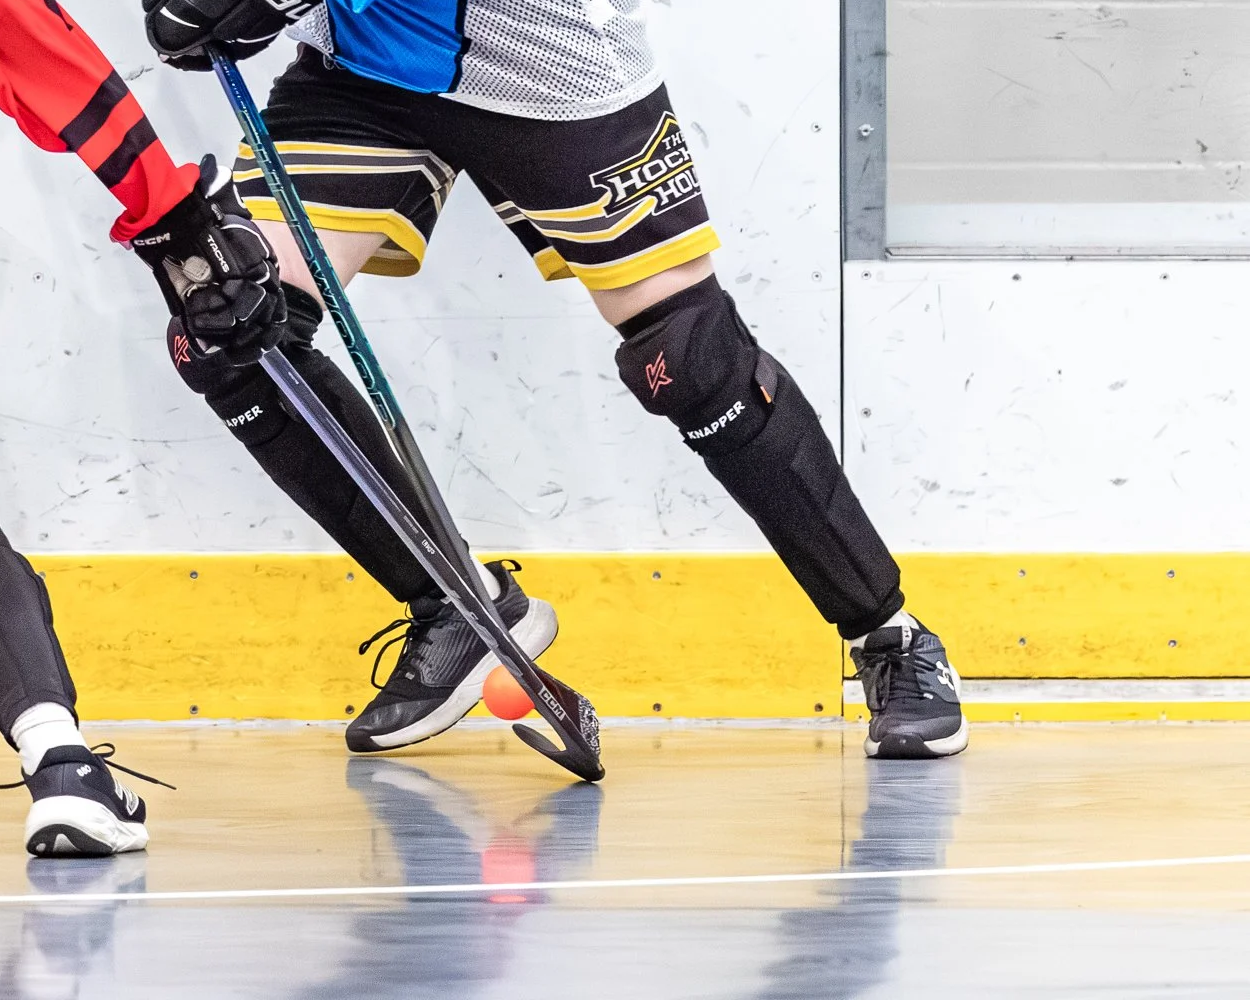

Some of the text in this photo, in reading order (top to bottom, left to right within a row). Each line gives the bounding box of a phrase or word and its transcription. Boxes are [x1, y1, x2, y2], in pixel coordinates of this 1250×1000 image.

[662, 132, 685, 150] TH
[133, 232, 171, 247] CCM
[207, 234, 230, 273] TACKS
[686, 400, 746, 440] KNAPPER
[540, 689, 565, 719] CCM
